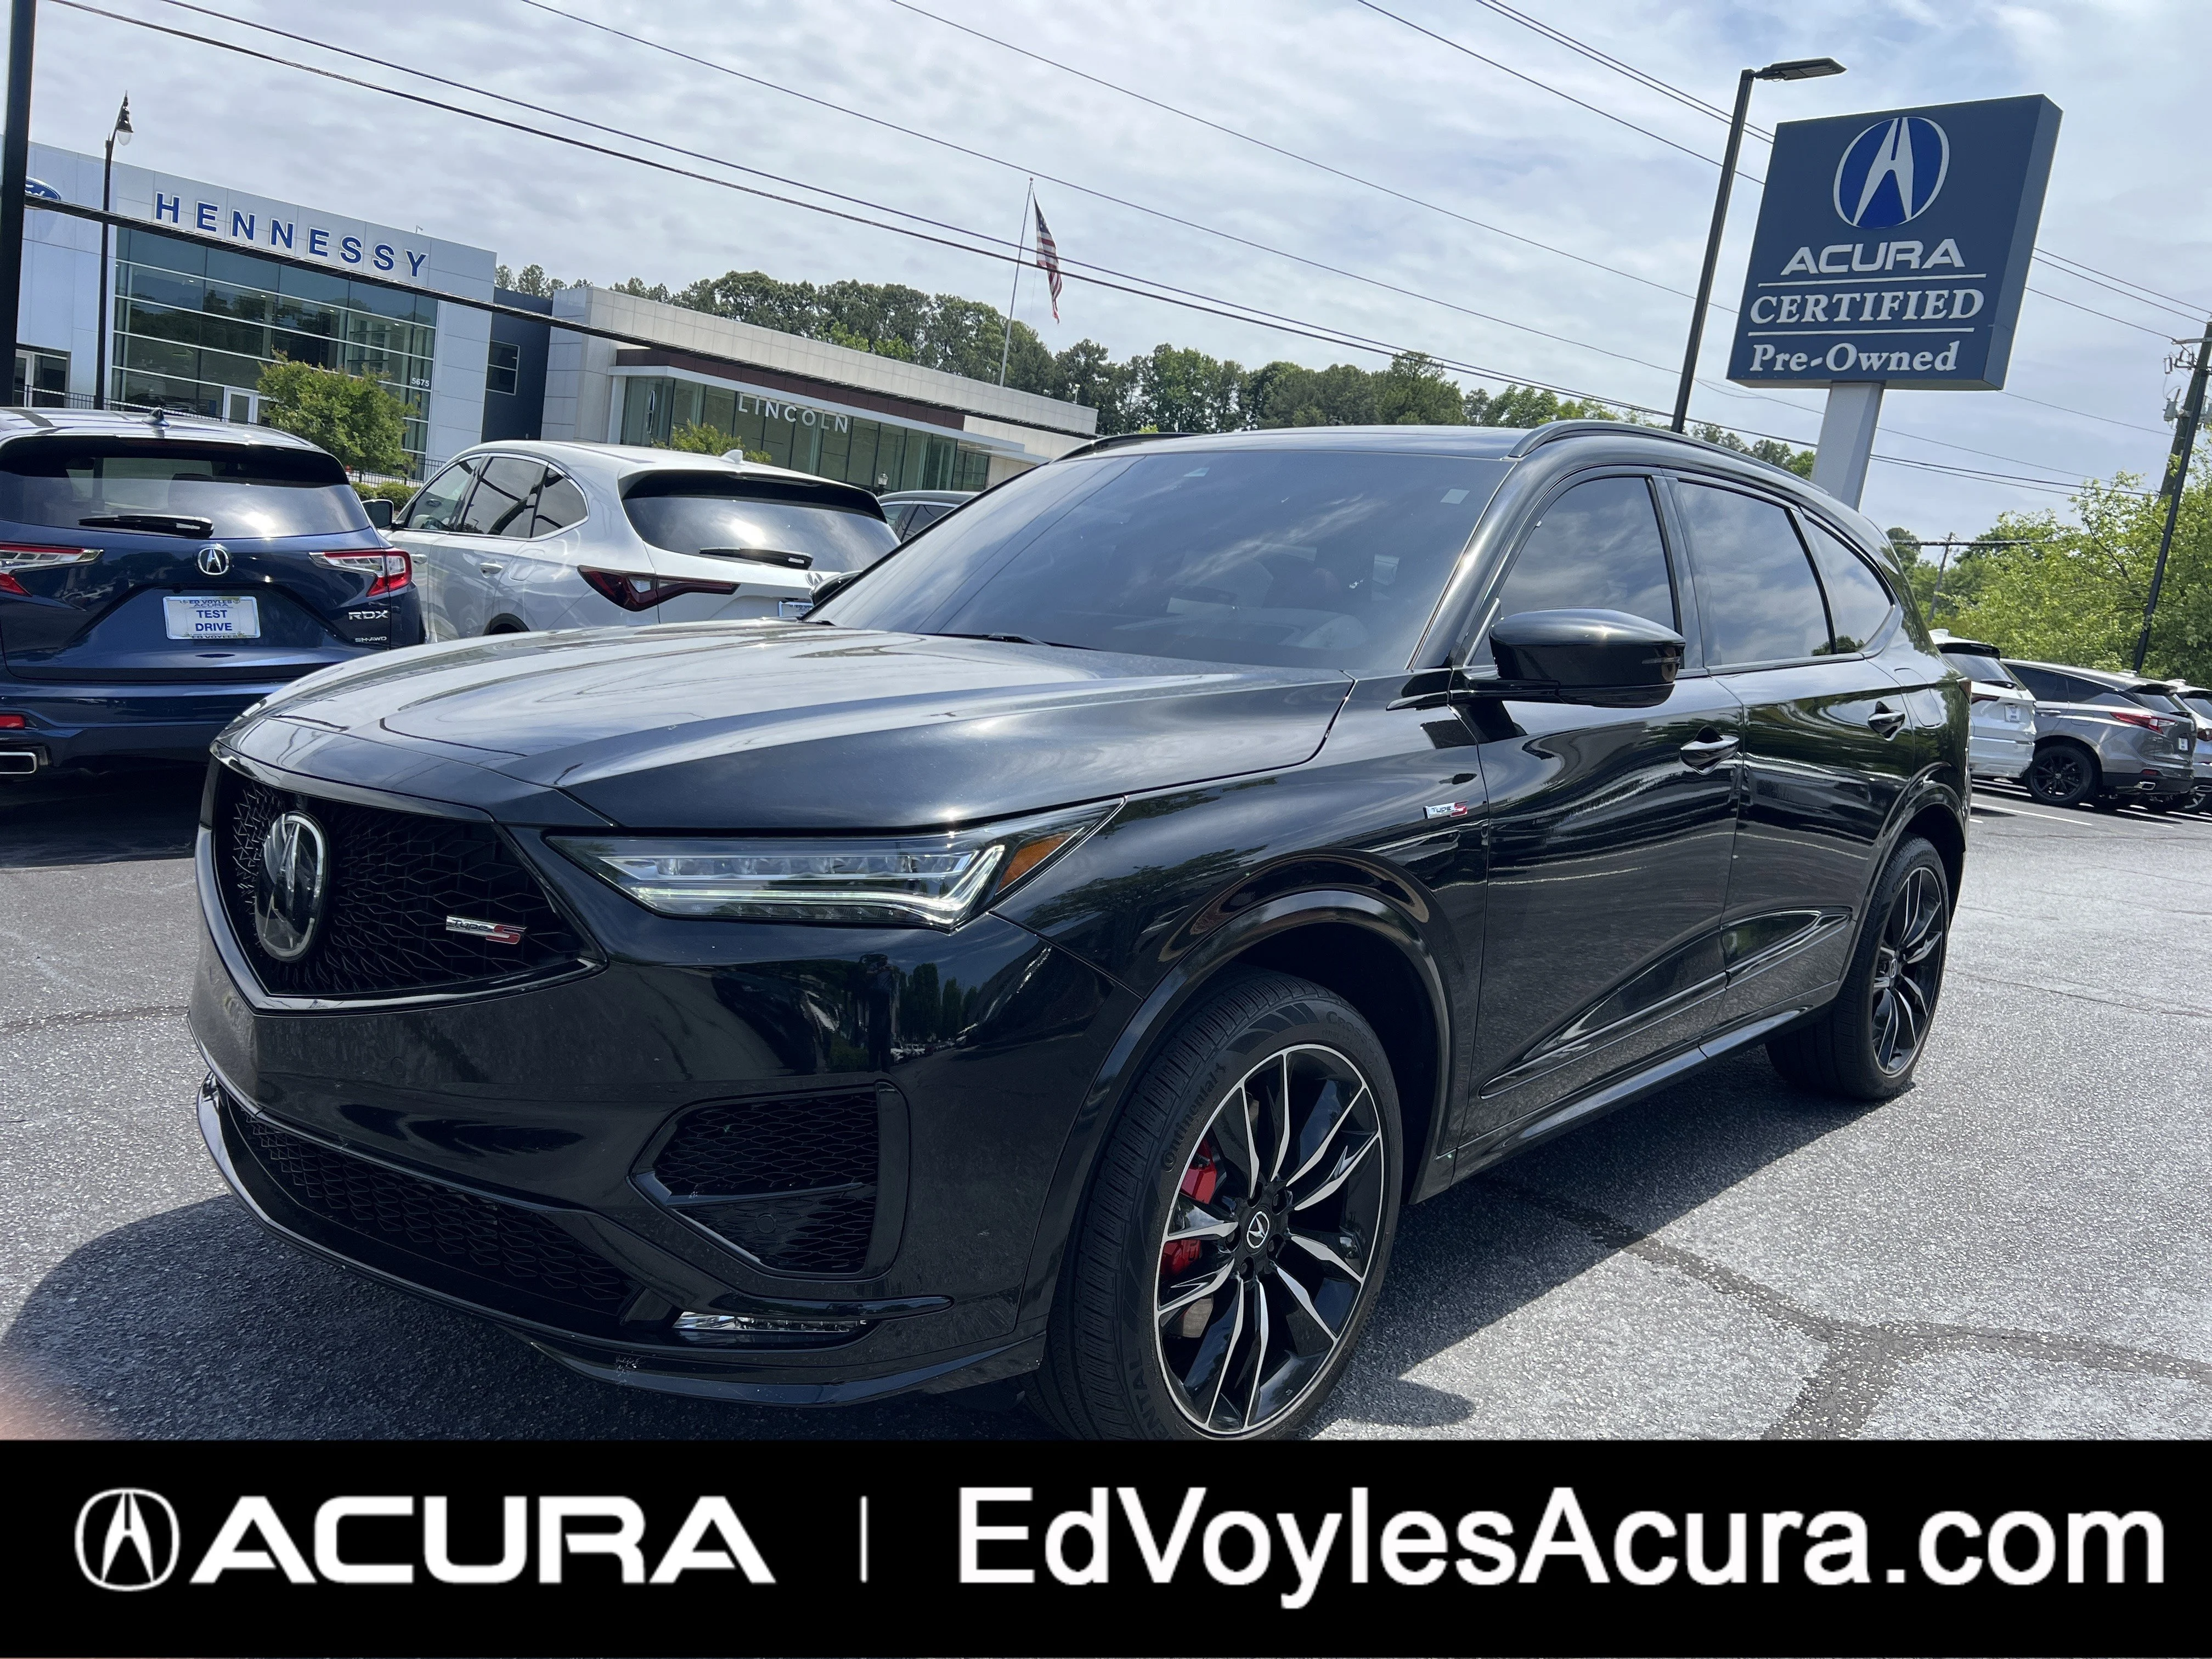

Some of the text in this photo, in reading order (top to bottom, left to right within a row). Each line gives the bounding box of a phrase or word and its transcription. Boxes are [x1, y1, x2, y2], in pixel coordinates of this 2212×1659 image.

[155, 191, 428, 277] HENNESSY
[1780, 239, 1965, 275] ACURA
[1750, 289, 1985, 325] CERTIFIED
[1749, 341, 1960, 371] Pre-Owned
[411, 377, 430, 387] 5675
[738, 394, 848, 433] LINCOLN
[195, 623, 233, 631] DRIVE
[196, 610, 228, 618] TEST
[348, 610, 389, 620] RDX
